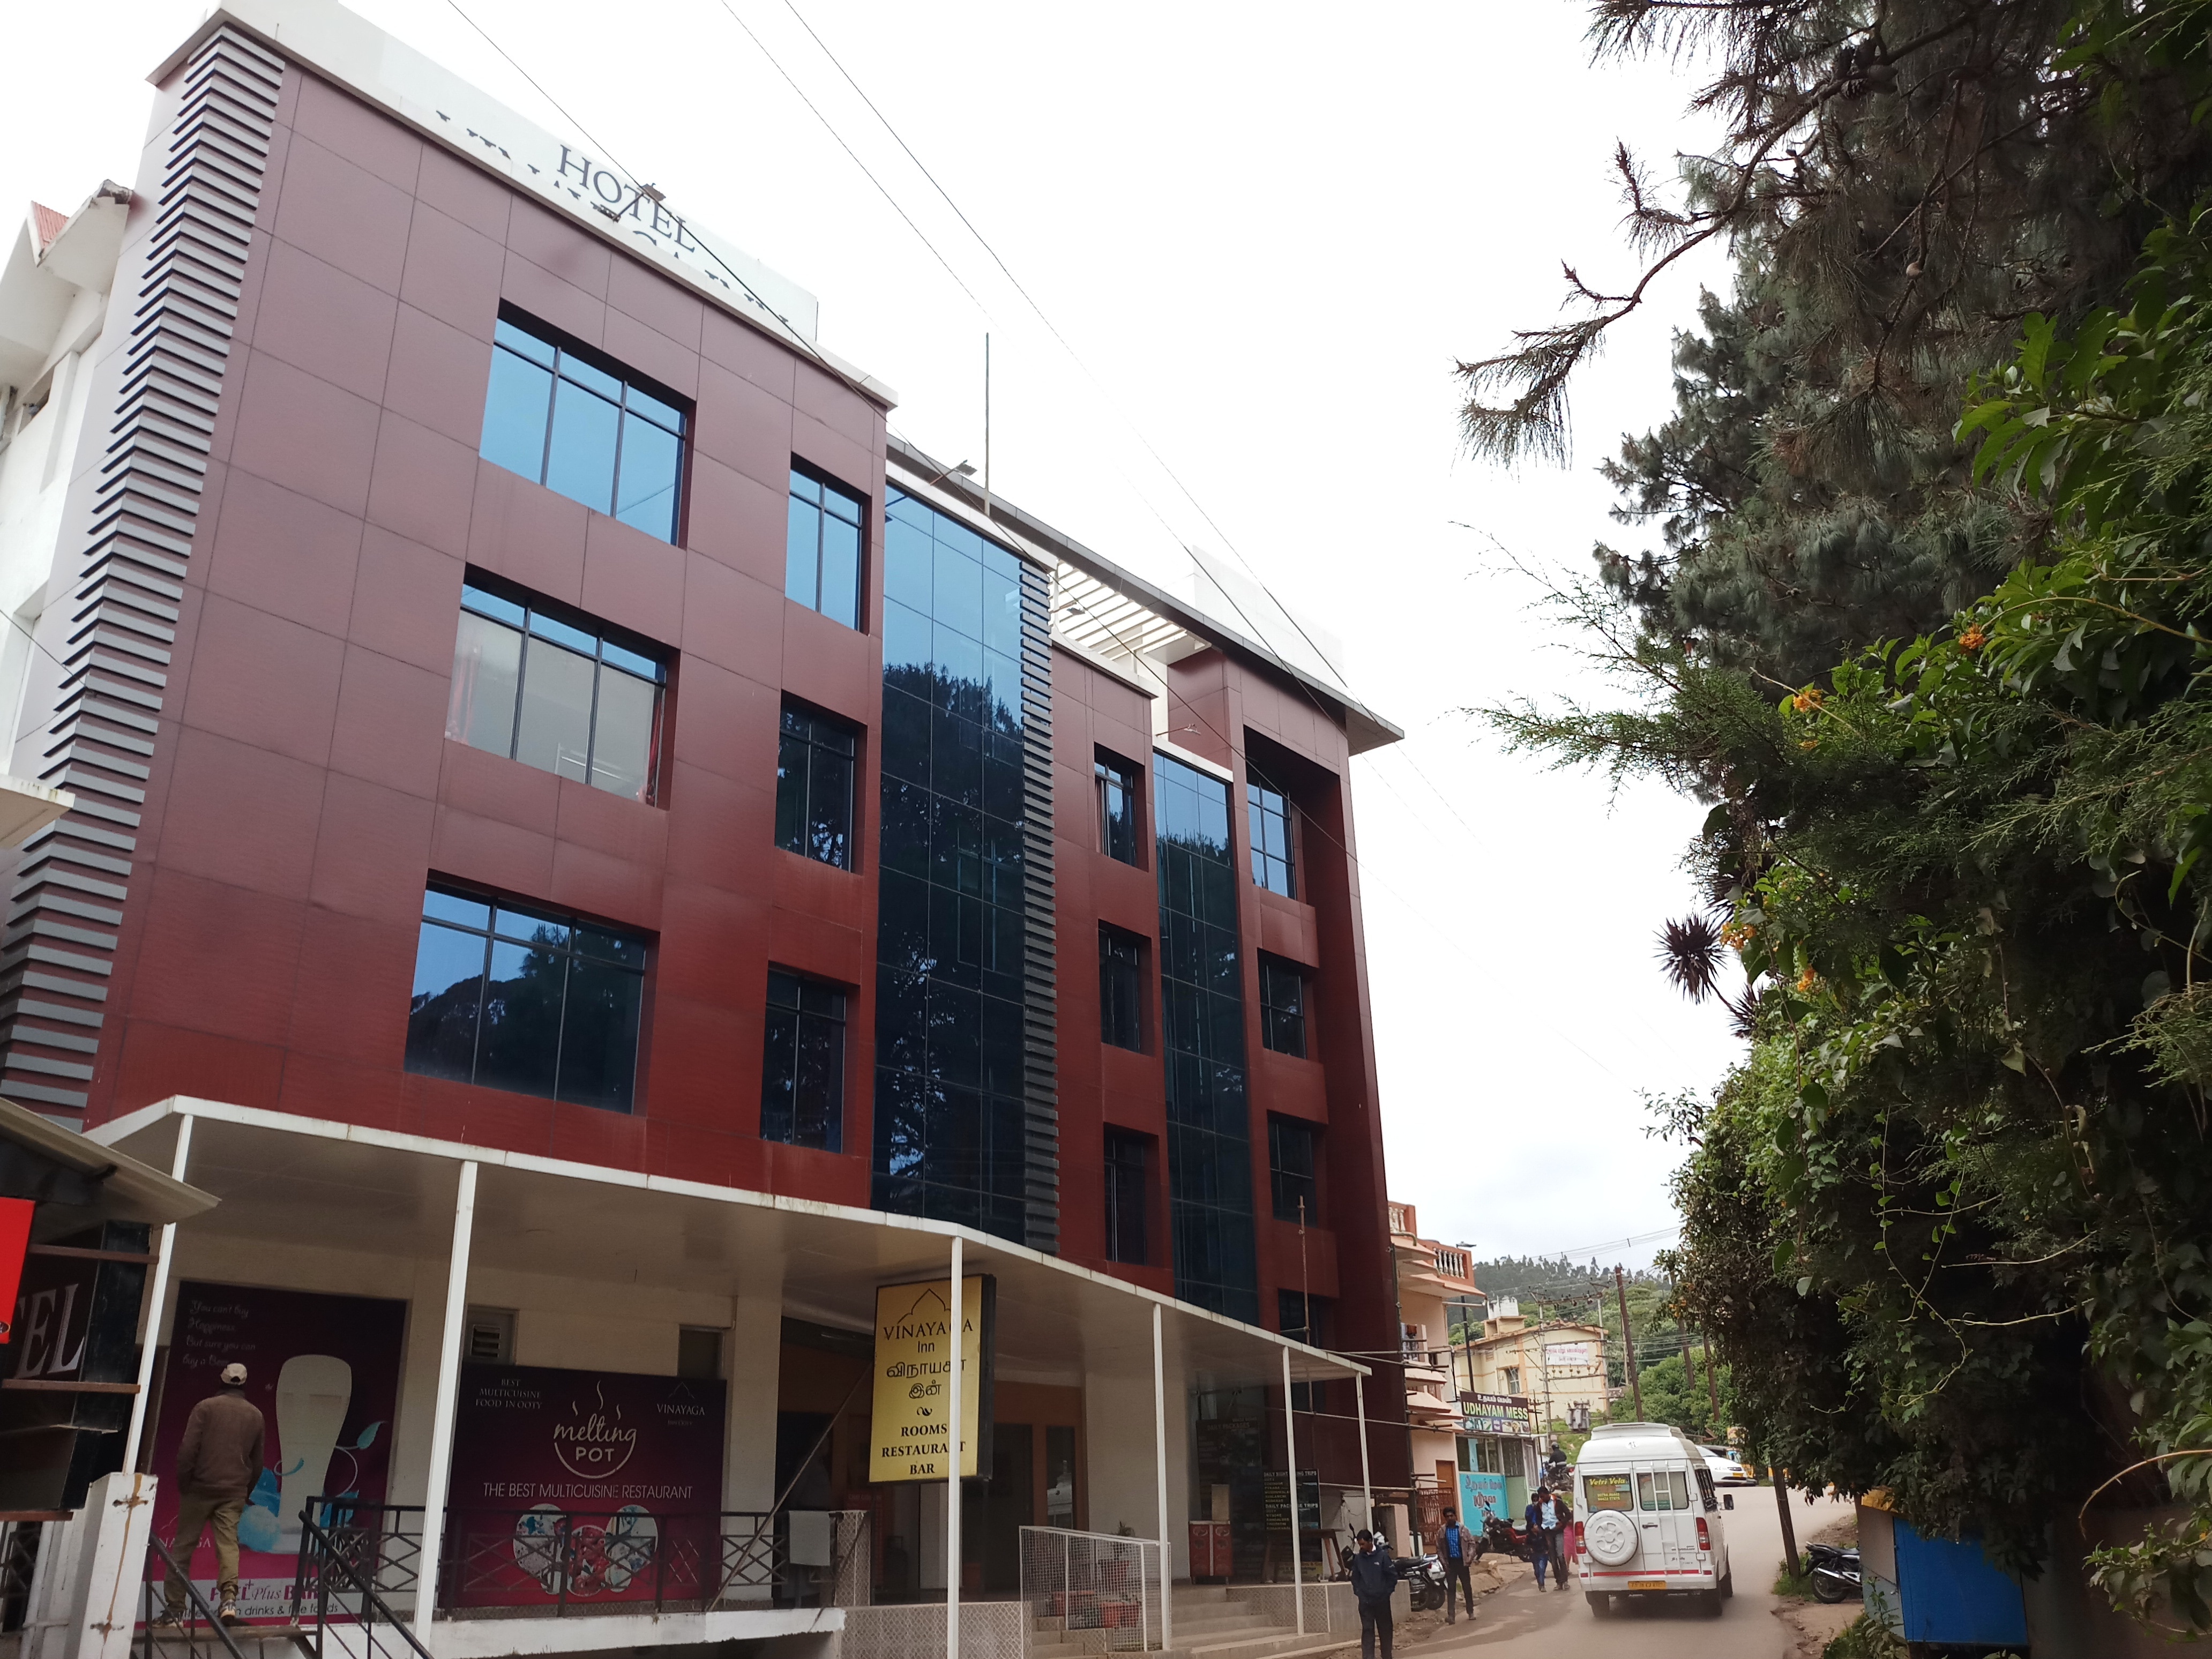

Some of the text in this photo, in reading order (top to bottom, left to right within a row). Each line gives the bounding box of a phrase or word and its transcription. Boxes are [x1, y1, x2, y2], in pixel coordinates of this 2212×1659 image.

[557, 144, 695, 253] HOTEL
[14, 1283, 85, 1379] EL
[883, 1318, 973, 1340] VINAYAA
[917, 1341, 935, 1353] Inn
[909, 1379, 941, 1399] இன்
[475, 1399, 502, 1407] FOOD
[656, 1403, 705, 1416] VINAYAGA
[1463, 1401, 1529, 1420] UDHAYAM MESS
[553, 1413, 637, 1443] melting
[901, 1423, 947, 1437] ROOMS
[576, 1446, 615, 1462] POT
[881, 1441, 966, 1457] RESTAURAT
[910, 1463, 935, 1474] BAR
[483, 1482, 693, 1499] THE BEST MULTICUISINE RESTAURANT
[245, 1605, 274, 1616] drinks
[278, 1605, 284, 1615] &
